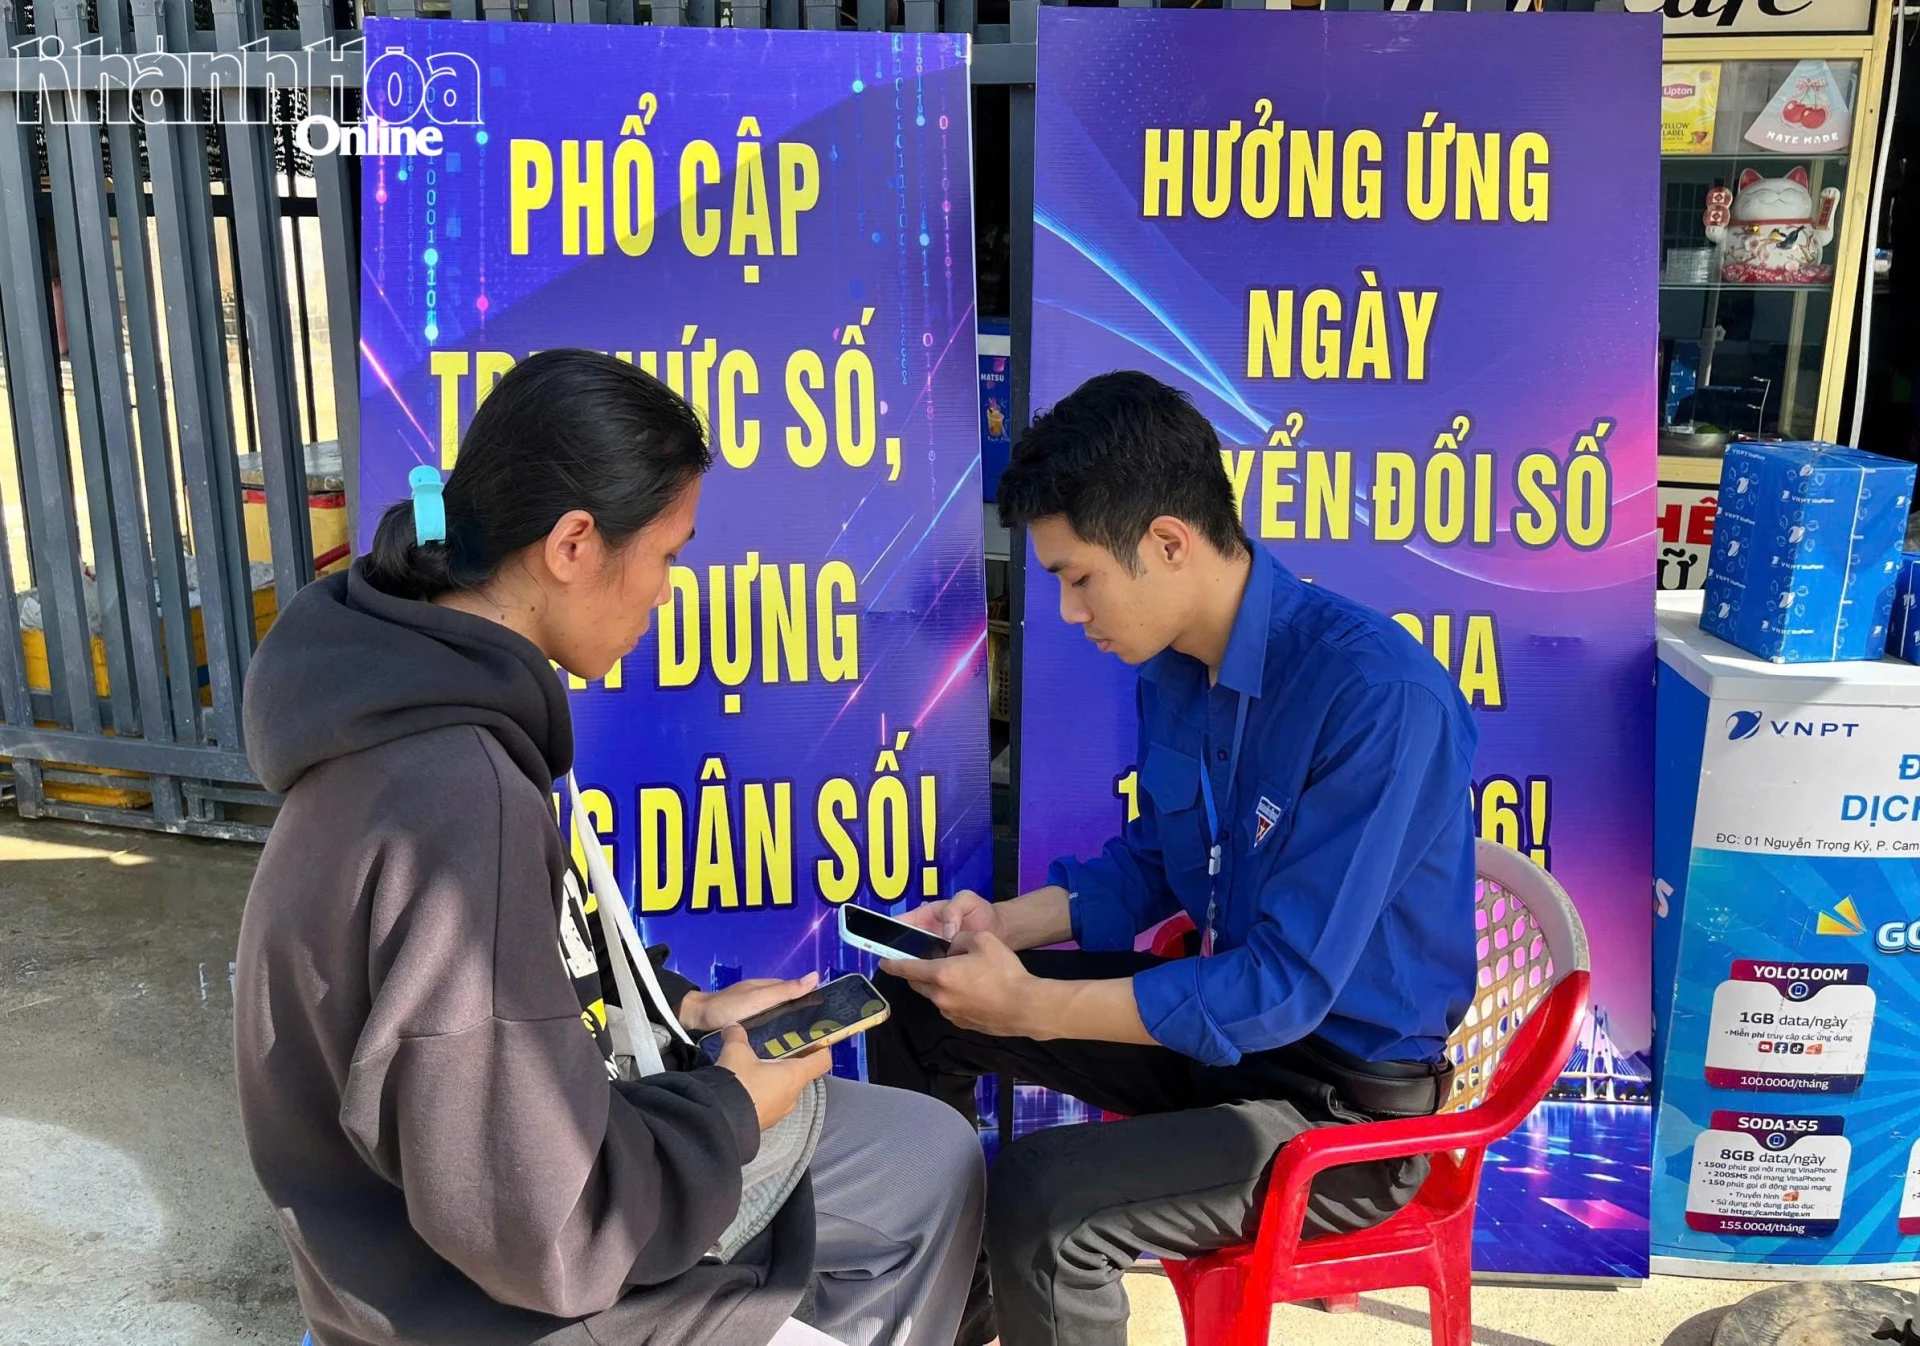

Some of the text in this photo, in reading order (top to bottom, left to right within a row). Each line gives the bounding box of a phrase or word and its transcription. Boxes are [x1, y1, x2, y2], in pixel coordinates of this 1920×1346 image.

[1663, 87, 1693, 97] Lipton
[1142, 97, 1550, 223] HƯỞNG ỨNG
[510, 93, 658, 256] PHỔ
[679, 116, 820, 283] CẬP
[1246, 270, 1439, 381] NGÀY
[980, 373, 1005, 382] MATSU
[785, 307, 902, 483] SỐ,
[1372, 415, 1493, 544] ĐỔI
[1515, 421, 1612, 547] SỐ
[657, 551, 859, 714] DỰNG
[1770, 720, 1860, 737] VNPT
[640, 757, 793, 913] DÂN
[816, 730, 940, 904] SỐ!
[1715, 833, 1741, 845] ĐC:
[1744, 836, 1760, 846] 01
[1764, 837, 1811, 852] Nguyễn
[1816, 839, 1850, 853] Trọng
[1876, 840, 1889, 851] P.
[1892, 841, 1920, 852] Cam
[1753, 965, 1849, 981] YOLO100M
[1739, 1011, 1848, 1029] 1GB data/ngày
[1766, 1032, 1783, 1042] truy
[1740, 1075, 1829, 1091] 100.000đ/tháng
[1737, 1116, 1819, 1132] SODA155
[1720, 1149, 1826, 1167] 8GB data/ngày
[1704, 1161, 1727, 1169] 1500
[1798, 1166, 1838, 1175] VinaPhone
[1708, 1179, 1725, 1187] 150
[1713, 1171, 1748, 1180] 200SMS
[1786, 1174, 1826, 1183] VinaPhone
[1720, 1220, 1805, 1234] 155.000đ/tháng
